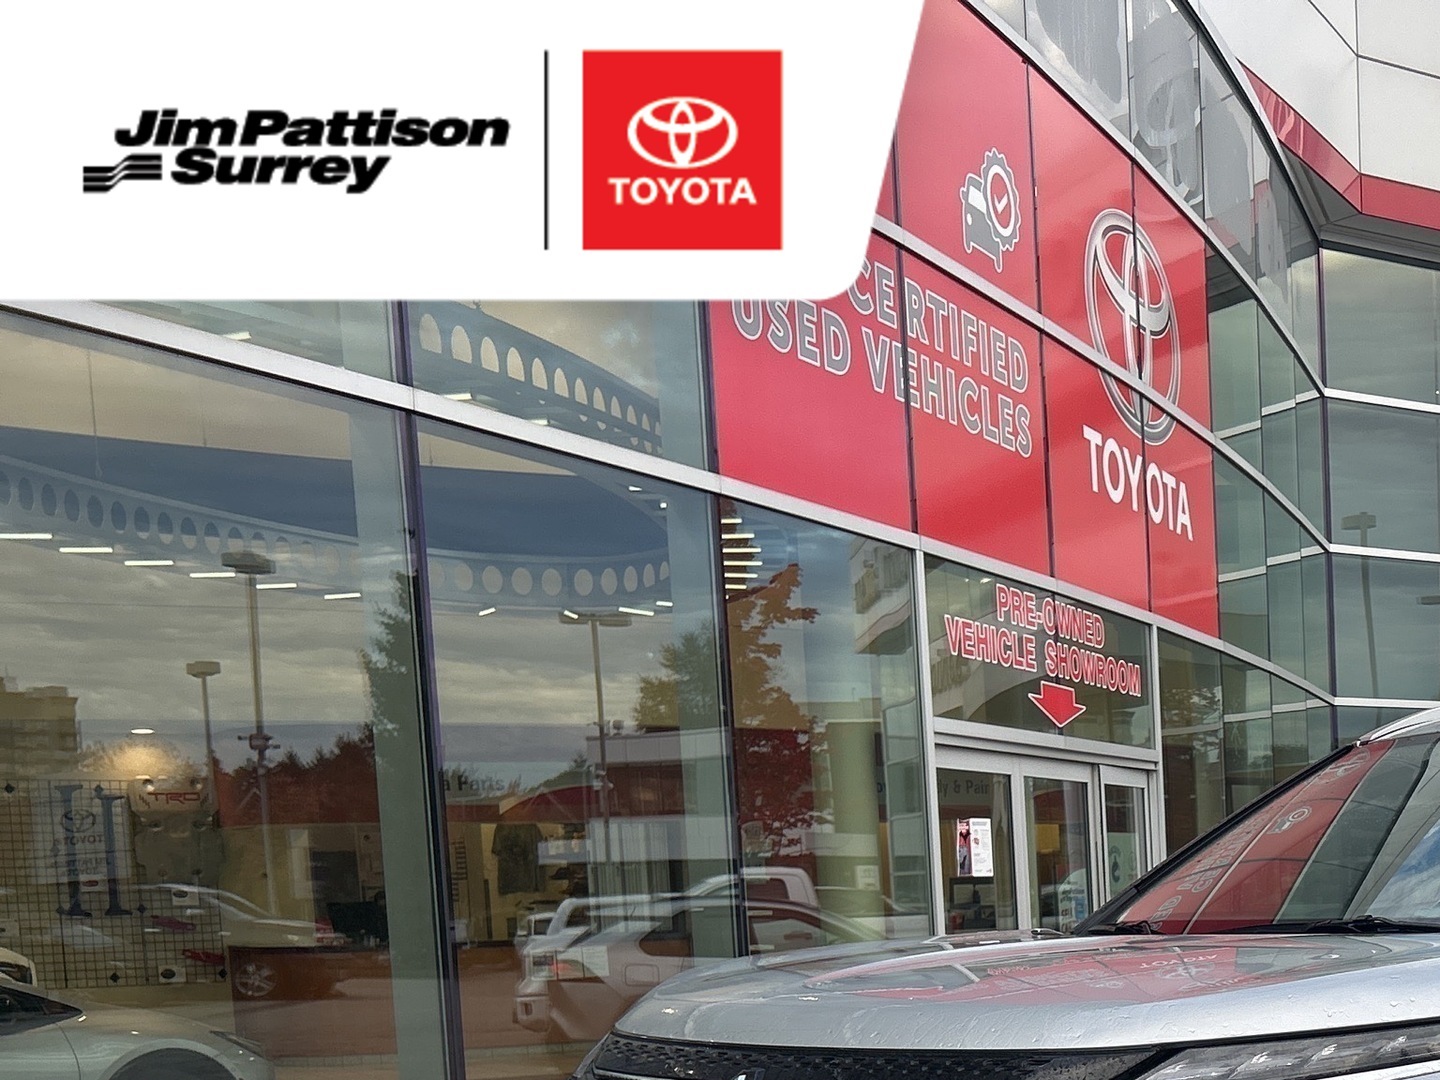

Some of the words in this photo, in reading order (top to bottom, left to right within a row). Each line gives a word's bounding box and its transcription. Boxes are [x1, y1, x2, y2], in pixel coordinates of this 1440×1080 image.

[732, 299, 851, 376] USED
[861, 325, 1033, 459] VEHICLES
[1082, 423, 1194, 542] TOYOTA
[944, 614, 1038, 673] VEHICLE
[1044, 639, 1142, 697] SHOWROOM
[995, 583, 1106, 649] PRE-OWNED
